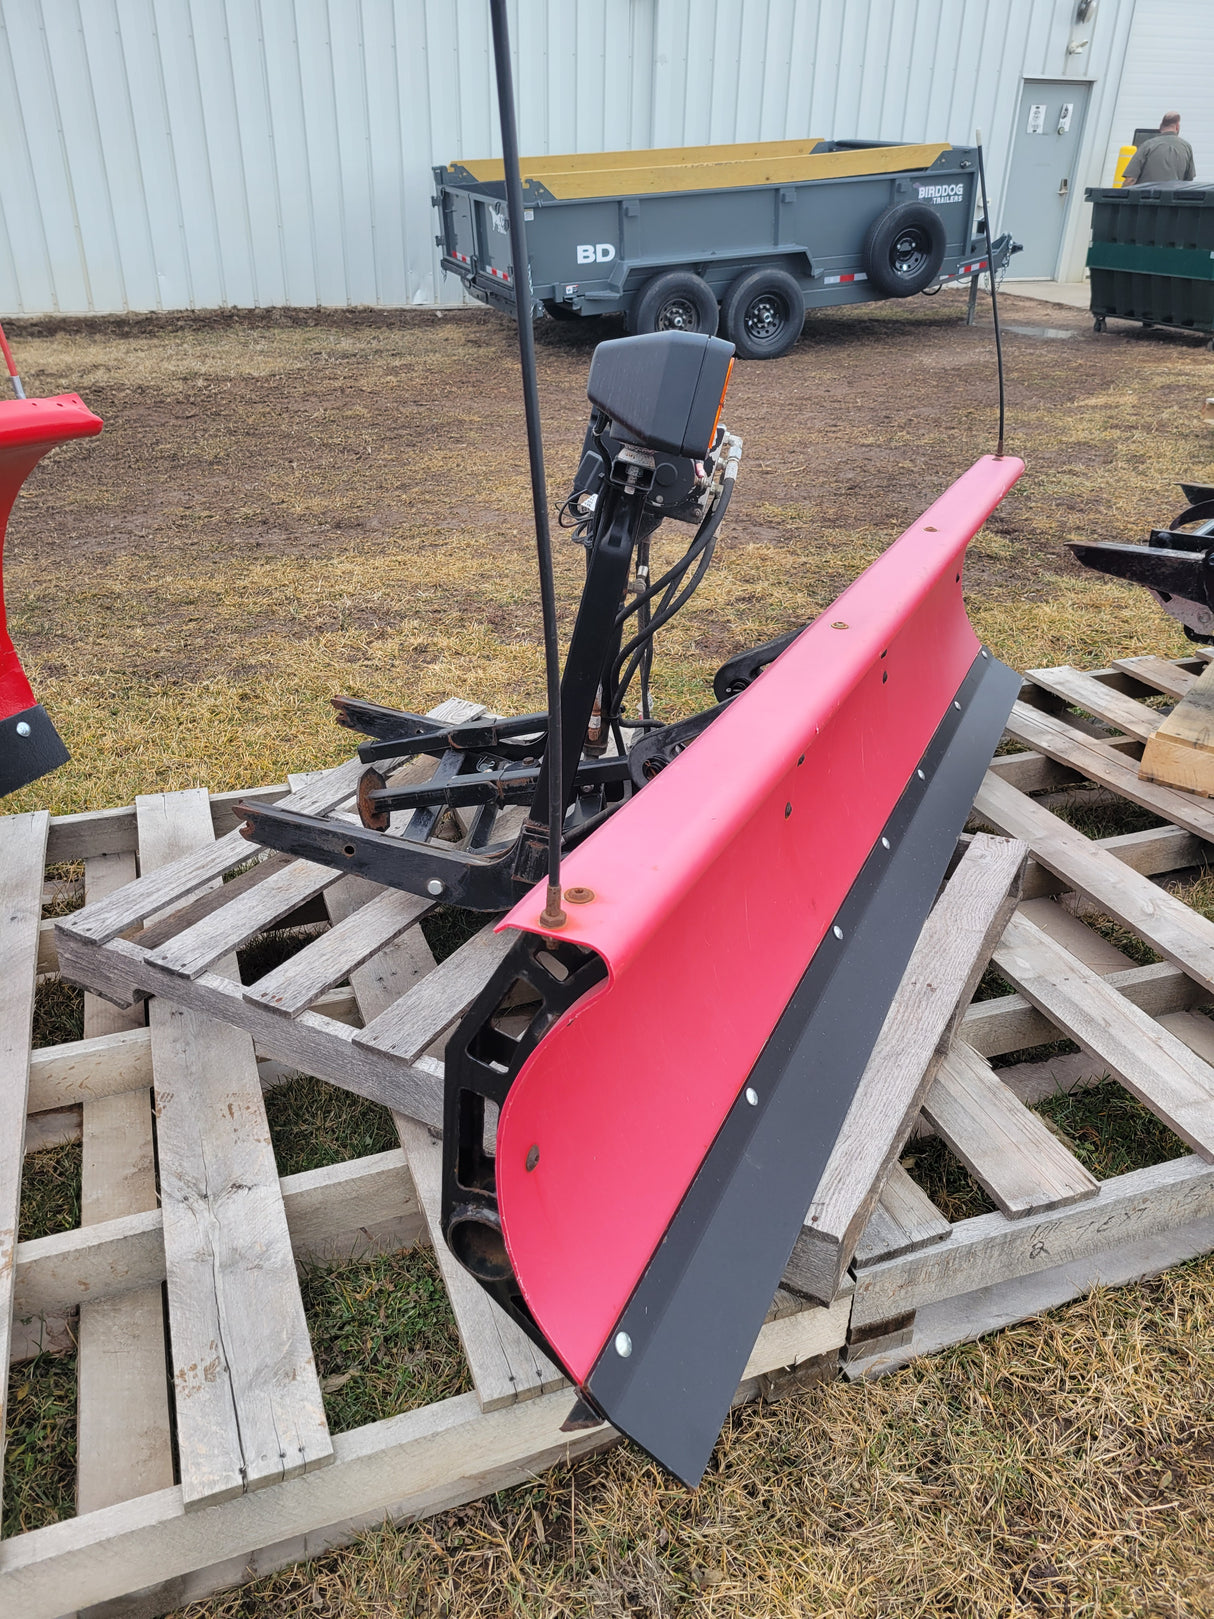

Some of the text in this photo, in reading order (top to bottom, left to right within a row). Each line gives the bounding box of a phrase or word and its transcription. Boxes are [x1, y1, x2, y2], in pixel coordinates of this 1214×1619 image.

[918, 184, 964, 199] BIRDDOG
[932, 195, 963, 205] TRAILERS
[576, 243, 616, 265] BD
